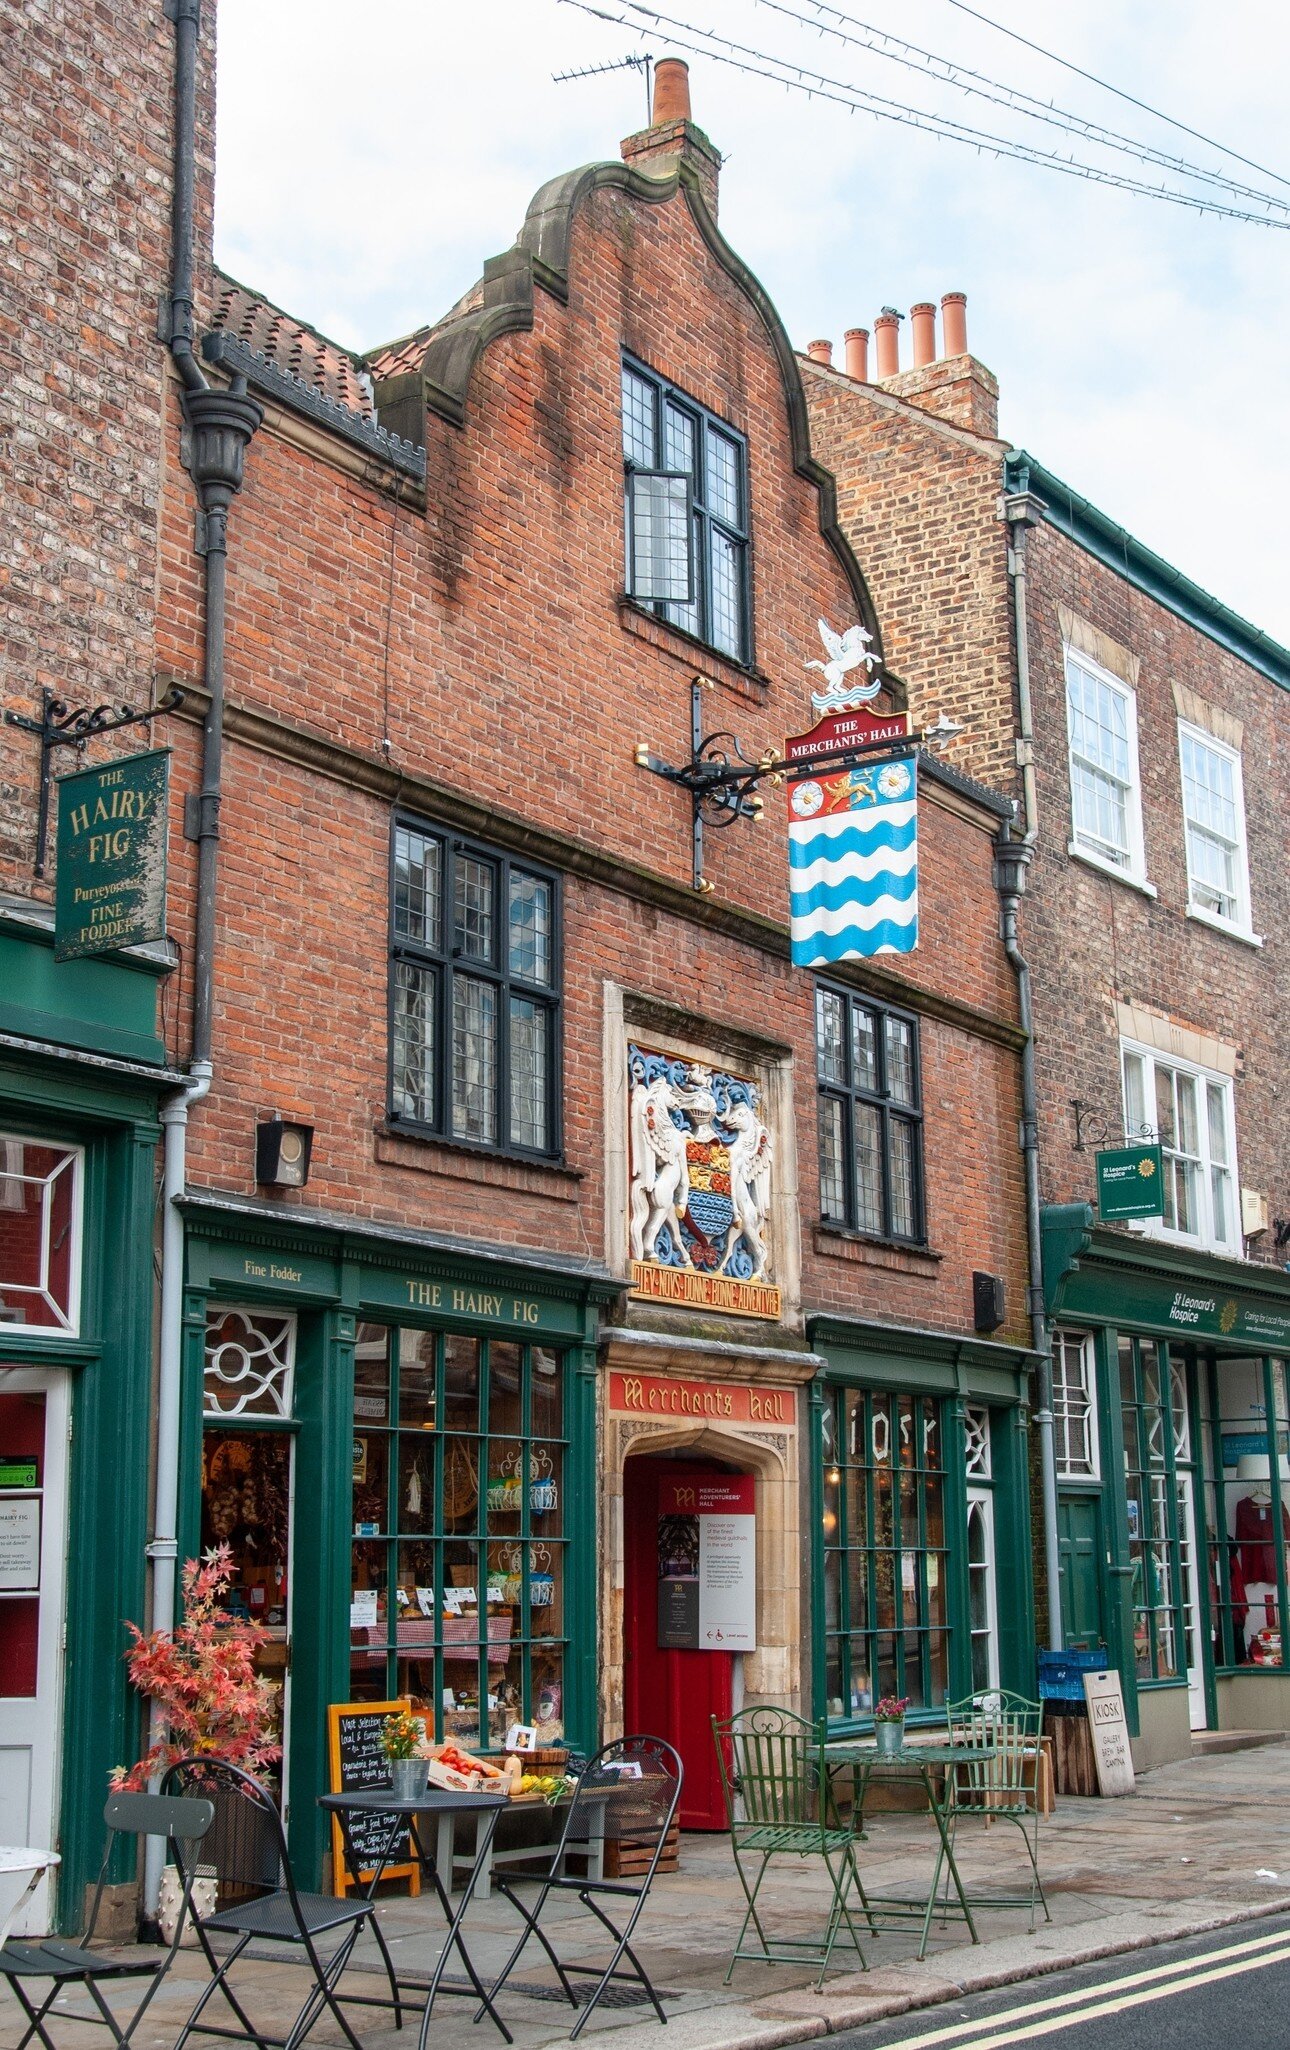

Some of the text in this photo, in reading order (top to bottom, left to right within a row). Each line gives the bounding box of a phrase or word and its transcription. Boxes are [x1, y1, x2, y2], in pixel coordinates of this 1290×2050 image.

[834, 720, 858, 735] THE
[870, 725, 903, 742] HALL
[98, 769, 125, 789] THE
[70, 790, 153, 836] HAIRY
[88, 828, 132, 863] FIG
[91, 902, 124, 924] FINE
[81, 918, 135, 943] FODDER
[244, 1259, 303, 1283] Fine Fodder
[406, 1280, 540, 1324] THE HAIRY FIG
[1173, 1292, 1216, 1312] St Leonard's
[1169, 1306, 1199, 1324] Hospice
[1096, 1702, 1120, 1719] KIOSK
